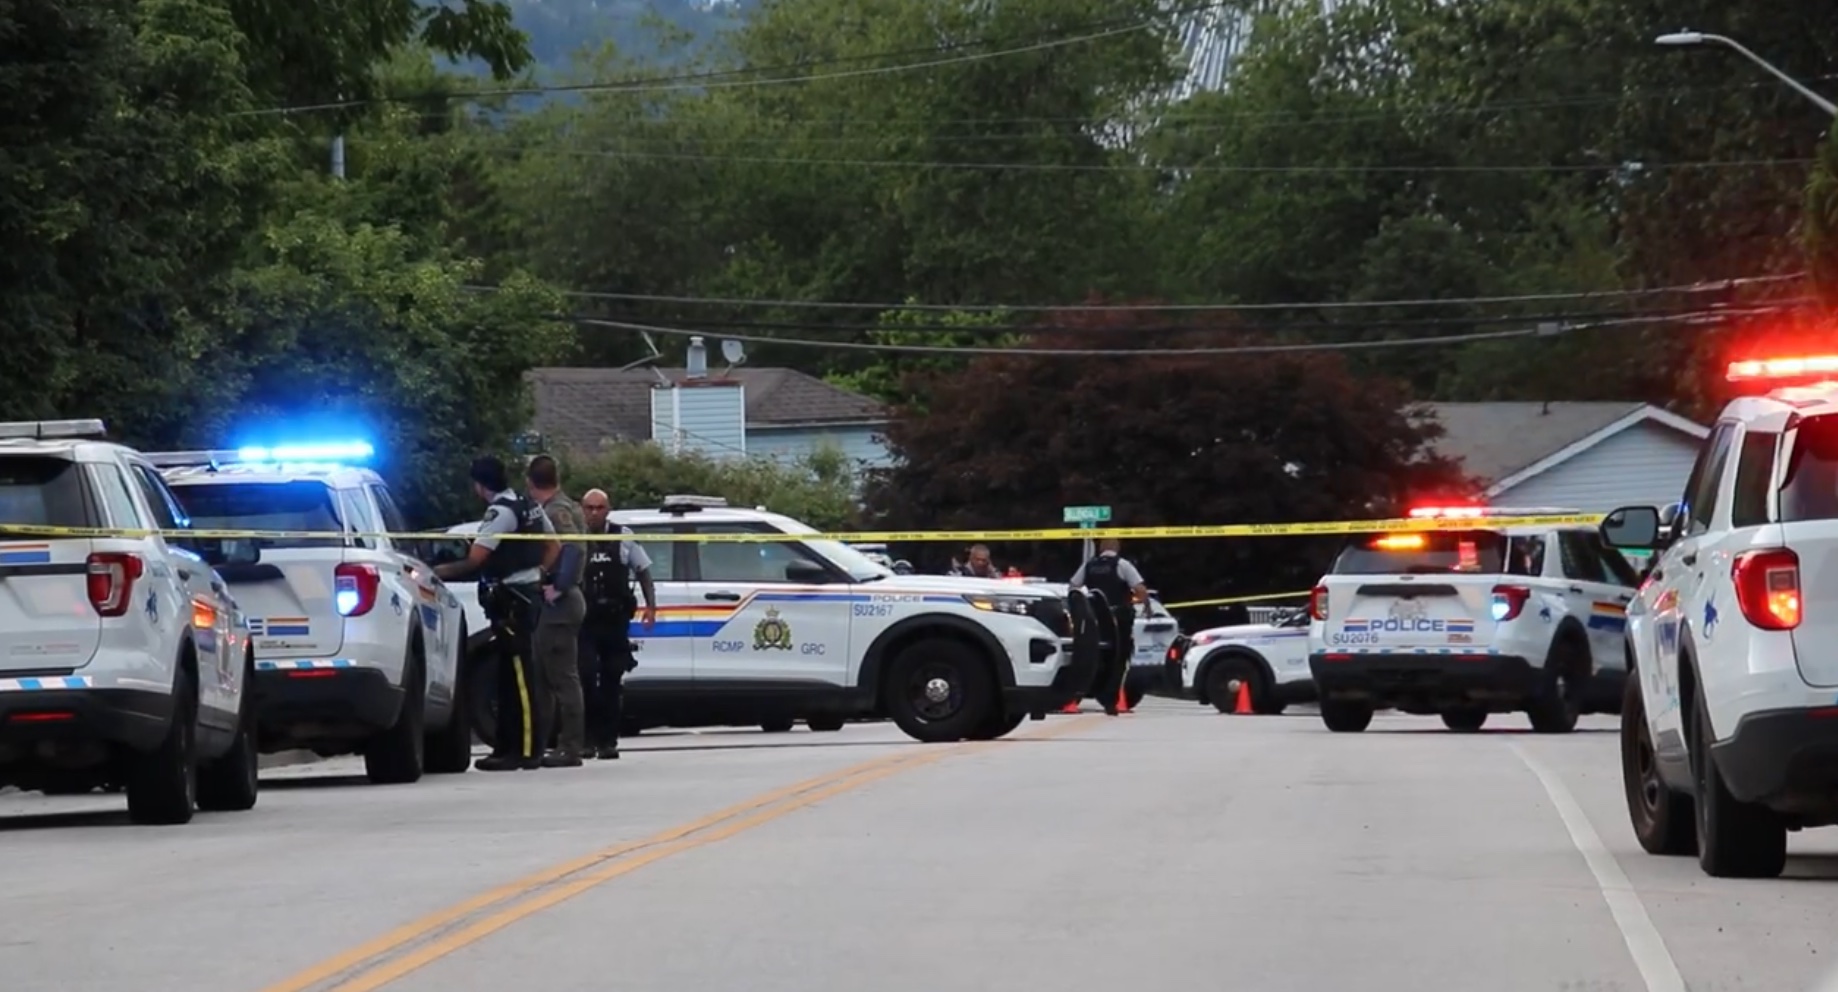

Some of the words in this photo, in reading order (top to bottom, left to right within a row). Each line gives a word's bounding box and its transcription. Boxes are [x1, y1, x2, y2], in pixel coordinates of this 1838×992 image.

[854, 604, 893, 616] SU2167
[1371, 619, 1445, 632] POLICE
[1333, 633, 1379, 644] SU2076
[712, 640, 744, 652] RCMP
[801, 643, 826, 655] GRC
